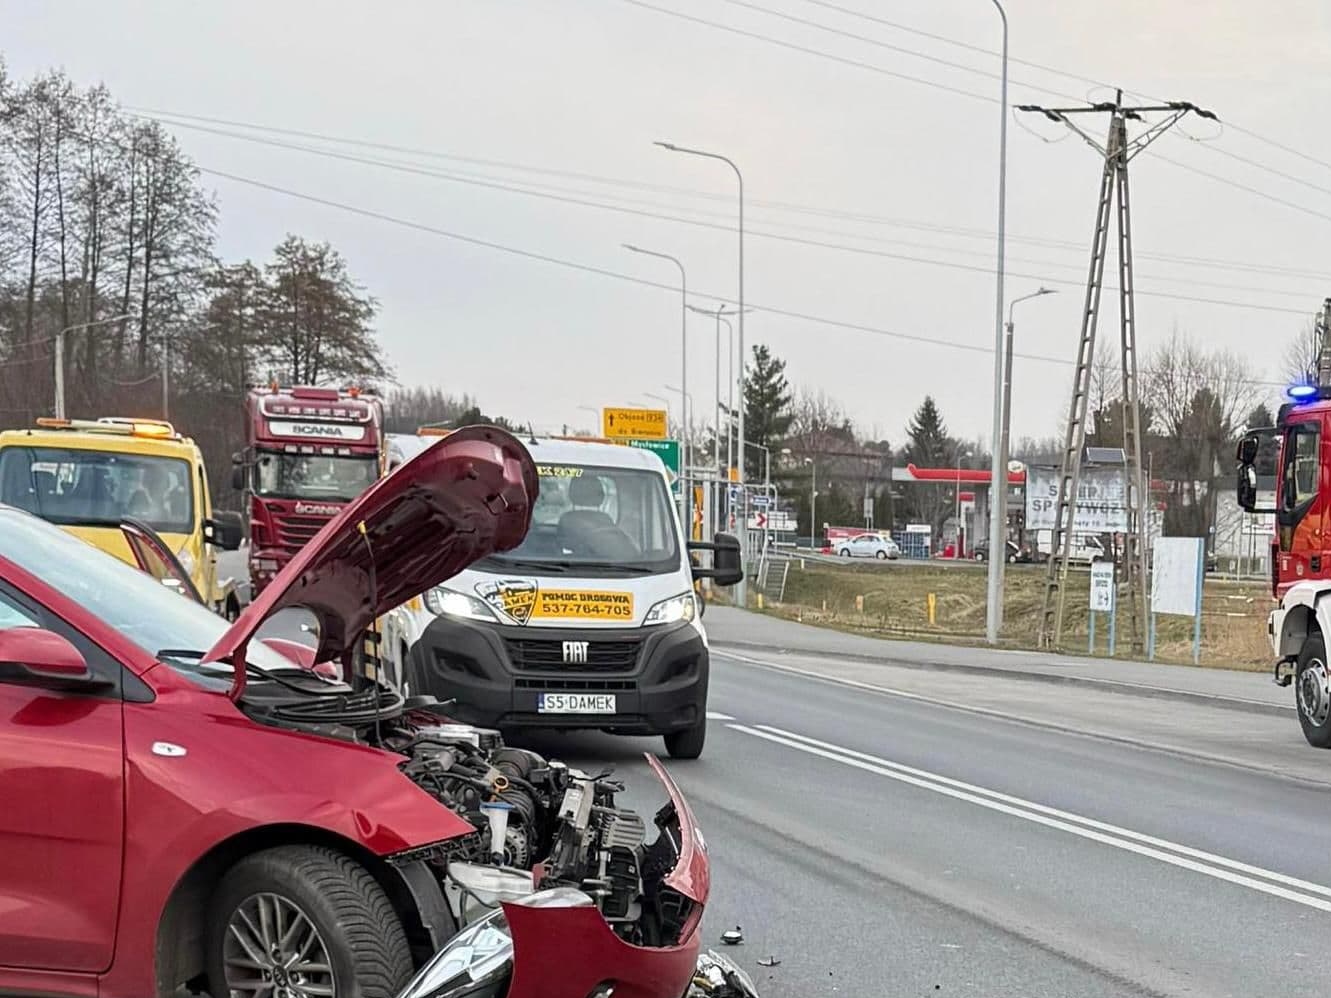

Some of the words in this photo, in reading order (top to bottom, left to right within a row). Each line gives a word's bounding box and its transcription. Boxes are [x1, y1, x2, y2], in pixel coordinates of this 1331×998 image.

[292, 425, 342, 435] SCANIA
[295, 502, 342, 514] SCANIA
[542, 593, 578, 601] POMOC
[580, 594, 630, 604] DROGOWA
[542, 603, 631, 616] 537-764-705
[562, 641, 589, 662] FIAT
[546, 696, 564, 709] S5
[569, 696, 614, 709] DAMEK
